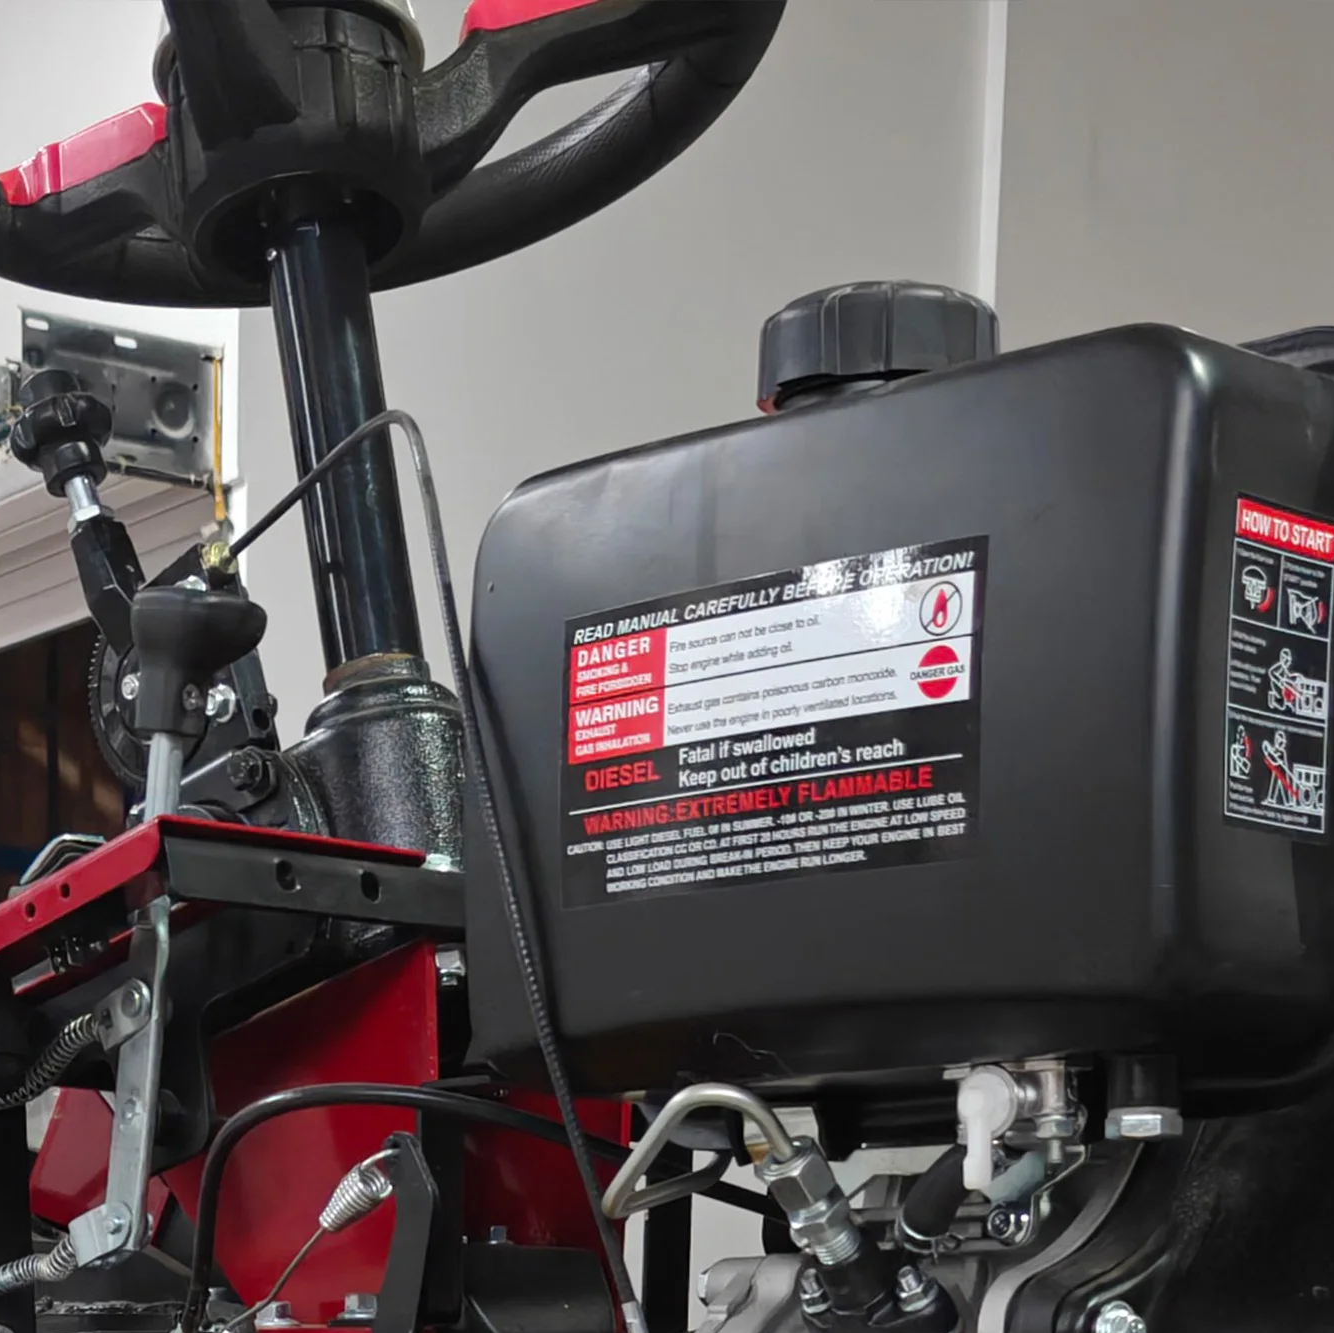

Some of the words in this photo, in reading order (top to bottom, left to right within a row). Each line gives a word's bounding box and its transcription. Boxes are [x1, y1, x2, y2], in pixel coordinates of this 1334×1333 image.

[1241, 508, 1270, 537] HOW
[1273, 518, 1290, 542] TO
[1291, 524, 1334, 553] START
[573, 623, 613, 645] READ
[617, 609, 679, 636] MANUAL
[684, 587, 780, 620] CAREFULLY
[783, 570, 857, 601] BEFORE
[859, 551, 975, 585] OPERATION!
[688, 637, 717, 650] source
[719, 633, 736, 644] can
[737, 629, 752, 640] not
[754, 624, 766, 637] be
[768, 619, 793, 633] close
[795, 616, 805, 628] to
[577, 636, 651, 667] DANGER
[691, 655, 720, 671] engine
[722, 651, 745, 664] while
[747, 644, 778, 660] adding
[909, 667, 945, 681] DANGER
[947, 664, 965, 676] GAS
[667, 700, 703, 715] Exhaust
[704, 698, 720, 712] gas
[762, 681, 810, 699] poisonous
[811, 676, 845, 692] carbon
[575, 697, 660, 729] WARNING
[668, 723, 692, 736] Never
[695, 720, 710, 731] use
[729, 710, 760, 726] engine
[762, 708, 770, 720] in
[772, 702, 801, 720] poorly
[803, 694, 850, 713] ventilated
[678, 743, 714, 766] Fatal
[719, 740, 731, 758] if
[732, 728, 816, 758] swallowed
[678, 769, 717, 788] Keep
[720, 763, 746, 781] out
[750, 755, 768, 777] of
[771, 745, 852, 774] children's
[856, 738, 904, 762] reach
[584, 761, 661, 792] DIESEL
[798, 764, 934, 808] FLAMMABLE
[889, 814, 904, 826] AT
[904, 811, 929, 825] LOW
[929, 807, 966, 822] SPEED
[892, 797, 915, 811] USE
[822, 836, 850, 850] KEEP
[850, 833, 879, 847] YOUR
[881, 828, 921, 843] ENGINE
[922, 826, 935, 838] IN
[937, 822, 966, 837] BEST
